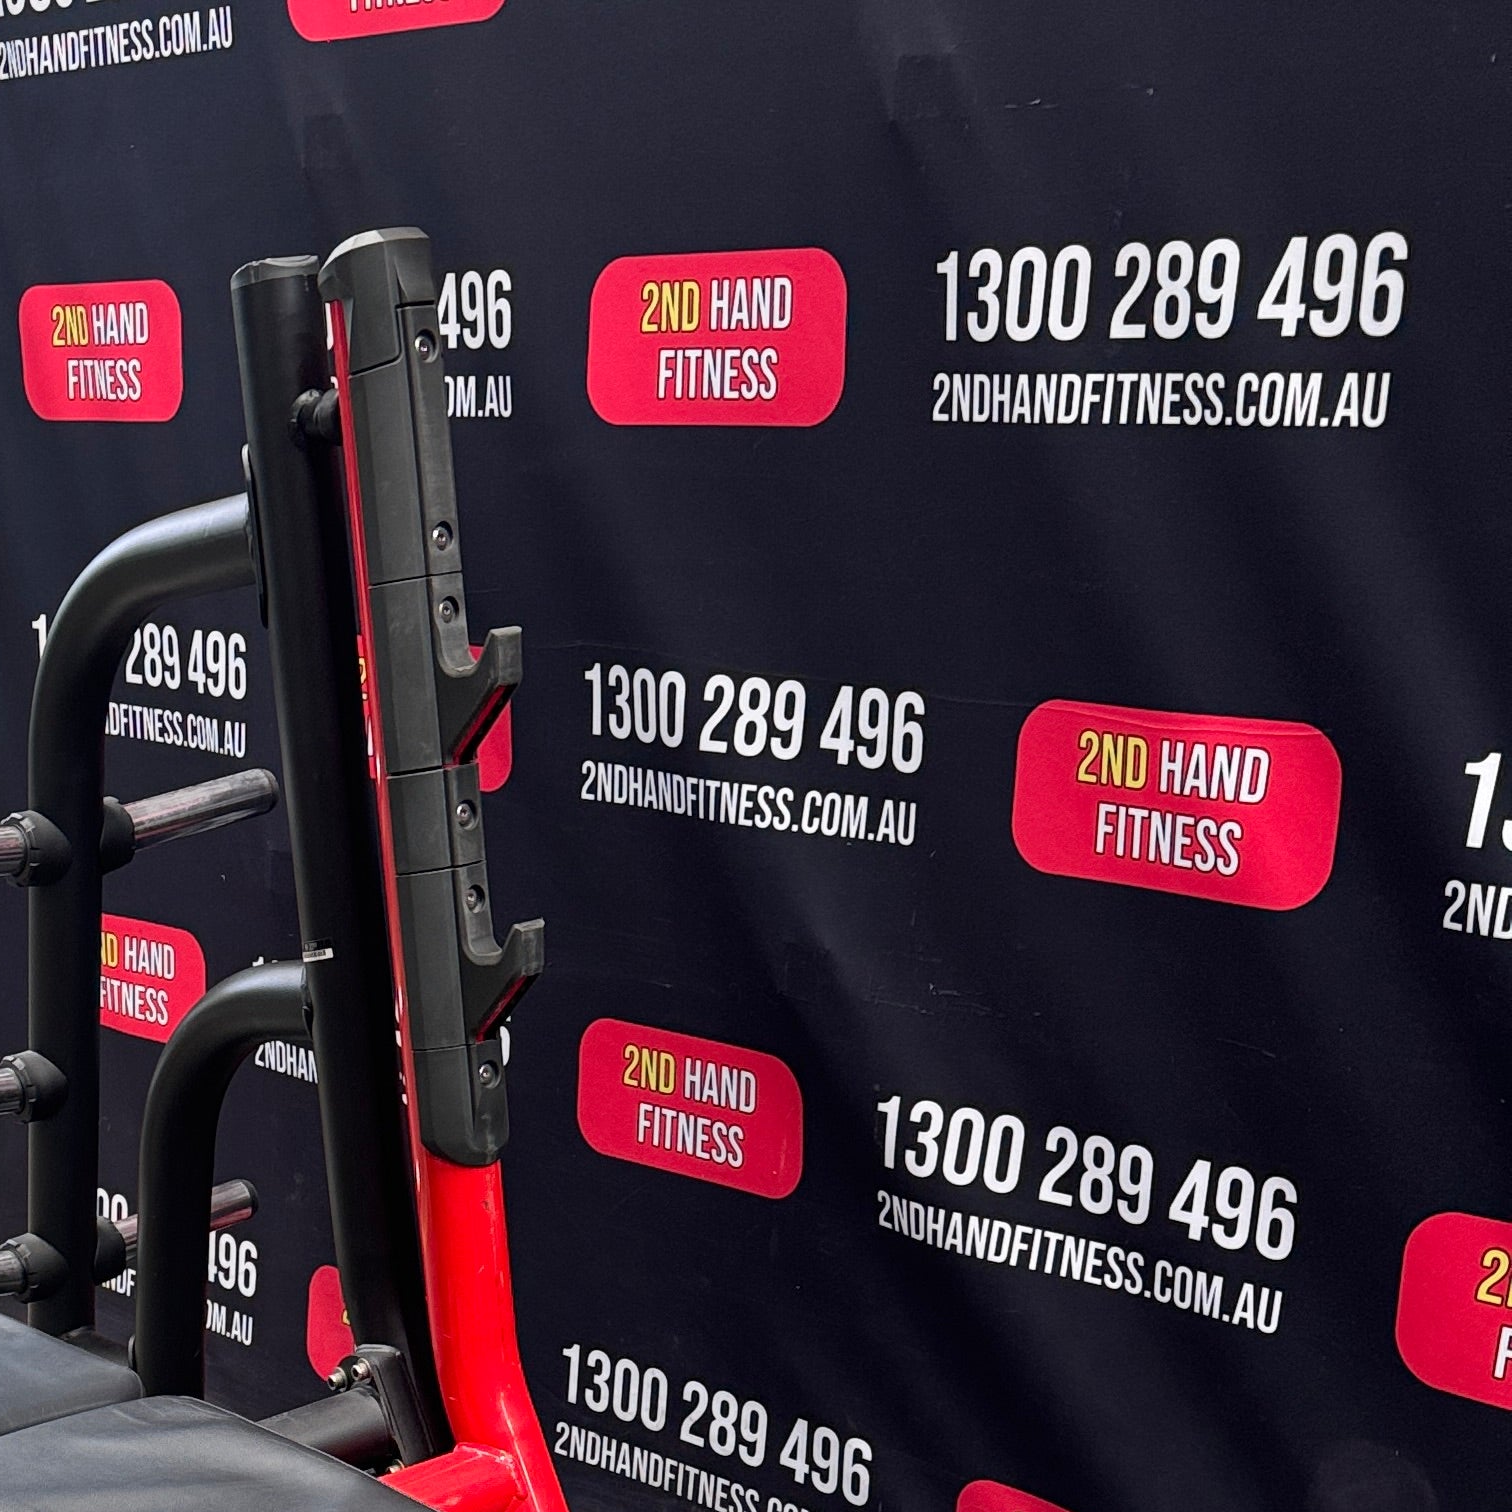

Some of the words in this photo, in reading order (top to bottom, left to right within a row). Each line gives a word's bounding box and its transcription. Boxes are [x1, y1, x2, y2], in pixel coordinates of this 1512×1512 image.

[437, 269, 512, 350] 496
[641, 281, 700, 332] 2ND
[710, 277, 792, 330] HAND
[936, 244, 1092, 343] 1300
[1109, 238, 1241, 340] 289
[1256, 231, 1408, 338] 496
[52, 305, 89, 346] 2ND
[91, 302, 149, 345] HAND
[67, 358, 142, 401] FITNESS
[658, 347, 778, 400] FITNESS
[932, 372, 1391, 428] 2NDHANDFITNESS.COM.AU
[125, 622, 181, 690] 289
[187, 629, 247, 700] 496
[104, 701, 246, 759] DFITNESS.COM.AU
[584, 662, 686, 748] 1300
[699, 674, 806, 761] 289
[819, 685, 925, 774] 496
[1077, 730, 1147, 789] 2ND
[1159, 740, 1270, 803] HAND
[580, 760, 917, 846] 2NDHANDFITNESS.COM.AU
[1095, 803, 1242, 876] FITNESS
[124, 935, 175, 980] HAND
[99, 975, 169, 1026] FITNESS
[623, 1044, 675, 1094] 2ND
[684, 1057, 756, 1113] HAND
[638, 1102, 744, 1168] FITNESS
[877, 1095, 1025, 1194] 1300
[1038, 1125, 1154, 1225] 289
[1168, 1159, 1298, 1261] 496
[877, 1190, 1283, 1334] 2NDHANDFITNESS.COM.AU
[562, 1343, 668, 1432] 1300
[679, 1380, 768, 1468] 289
[779, 1418, 873, 1507] 496
